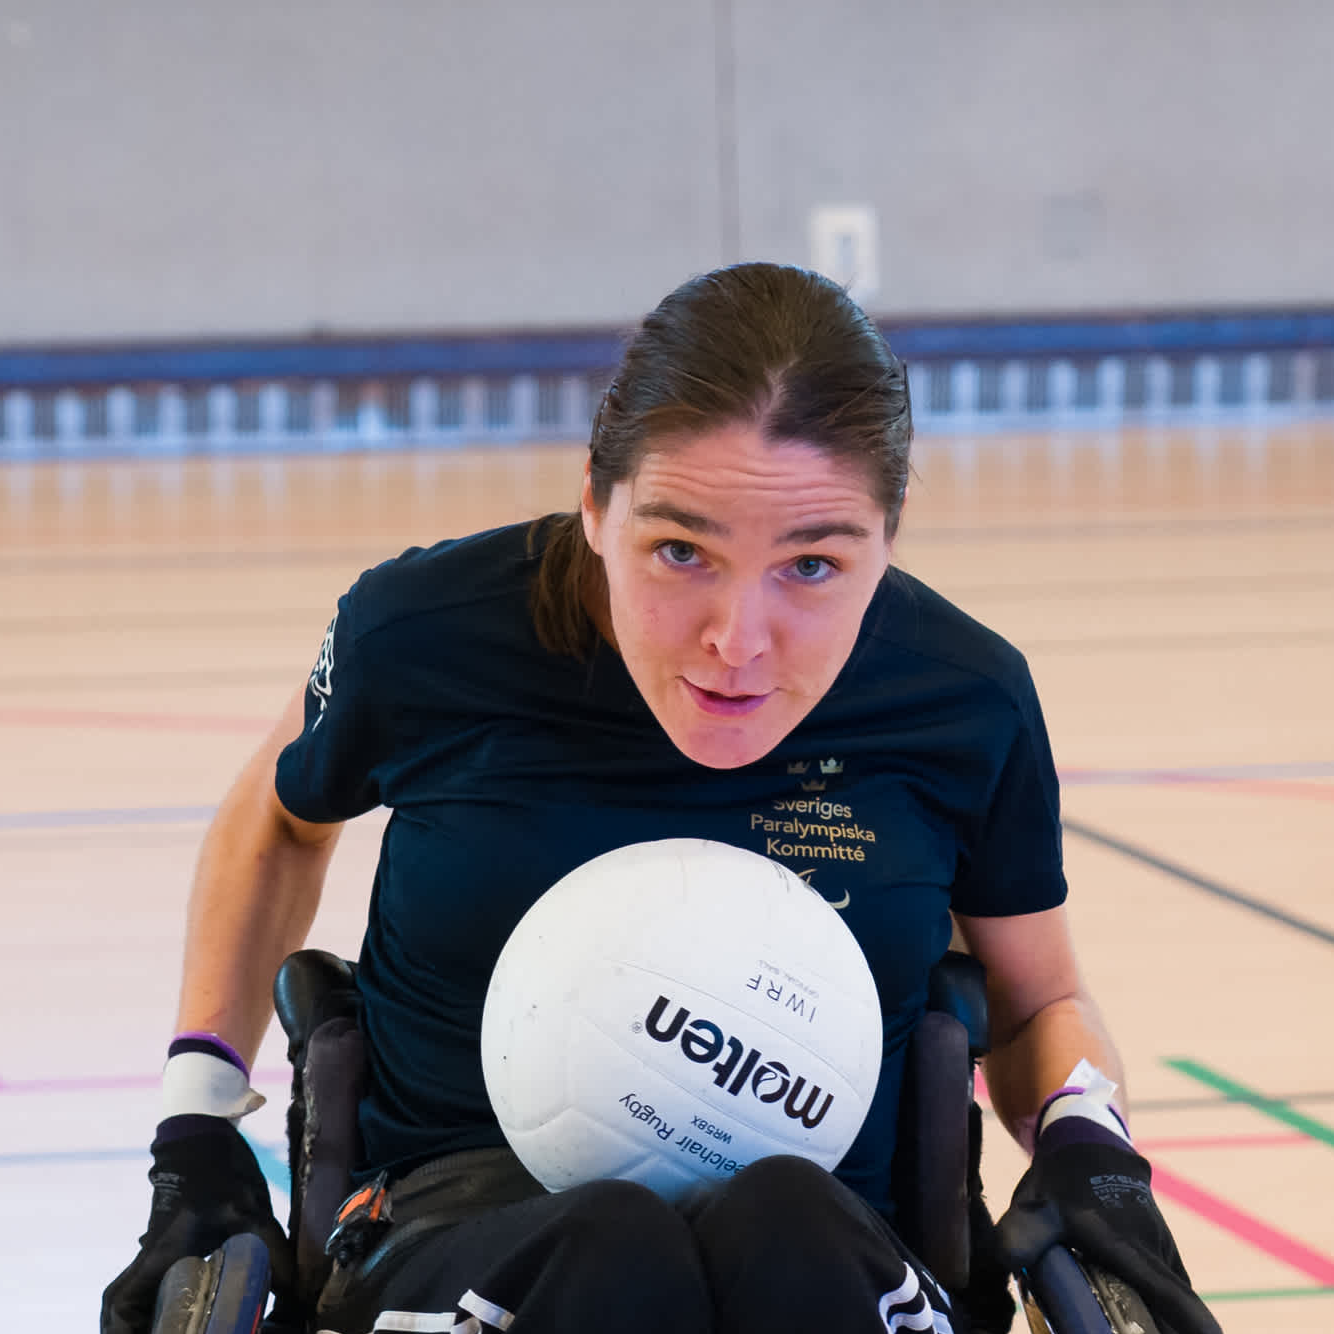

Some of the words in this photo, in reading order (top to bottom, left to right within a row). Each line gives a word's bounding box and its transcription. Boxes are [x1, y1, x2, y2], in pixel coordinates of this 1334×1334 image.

[772, 797, 852, 820] Sveriges
[750, 813, 876, 843] Paralympiska
[766, 838, 866, 862] Kommitté
[645, 995, 835, 1129] molten
[619, 1093, 675, 1140] Rugby
[675, 1136, 747, 1174] eelchair
